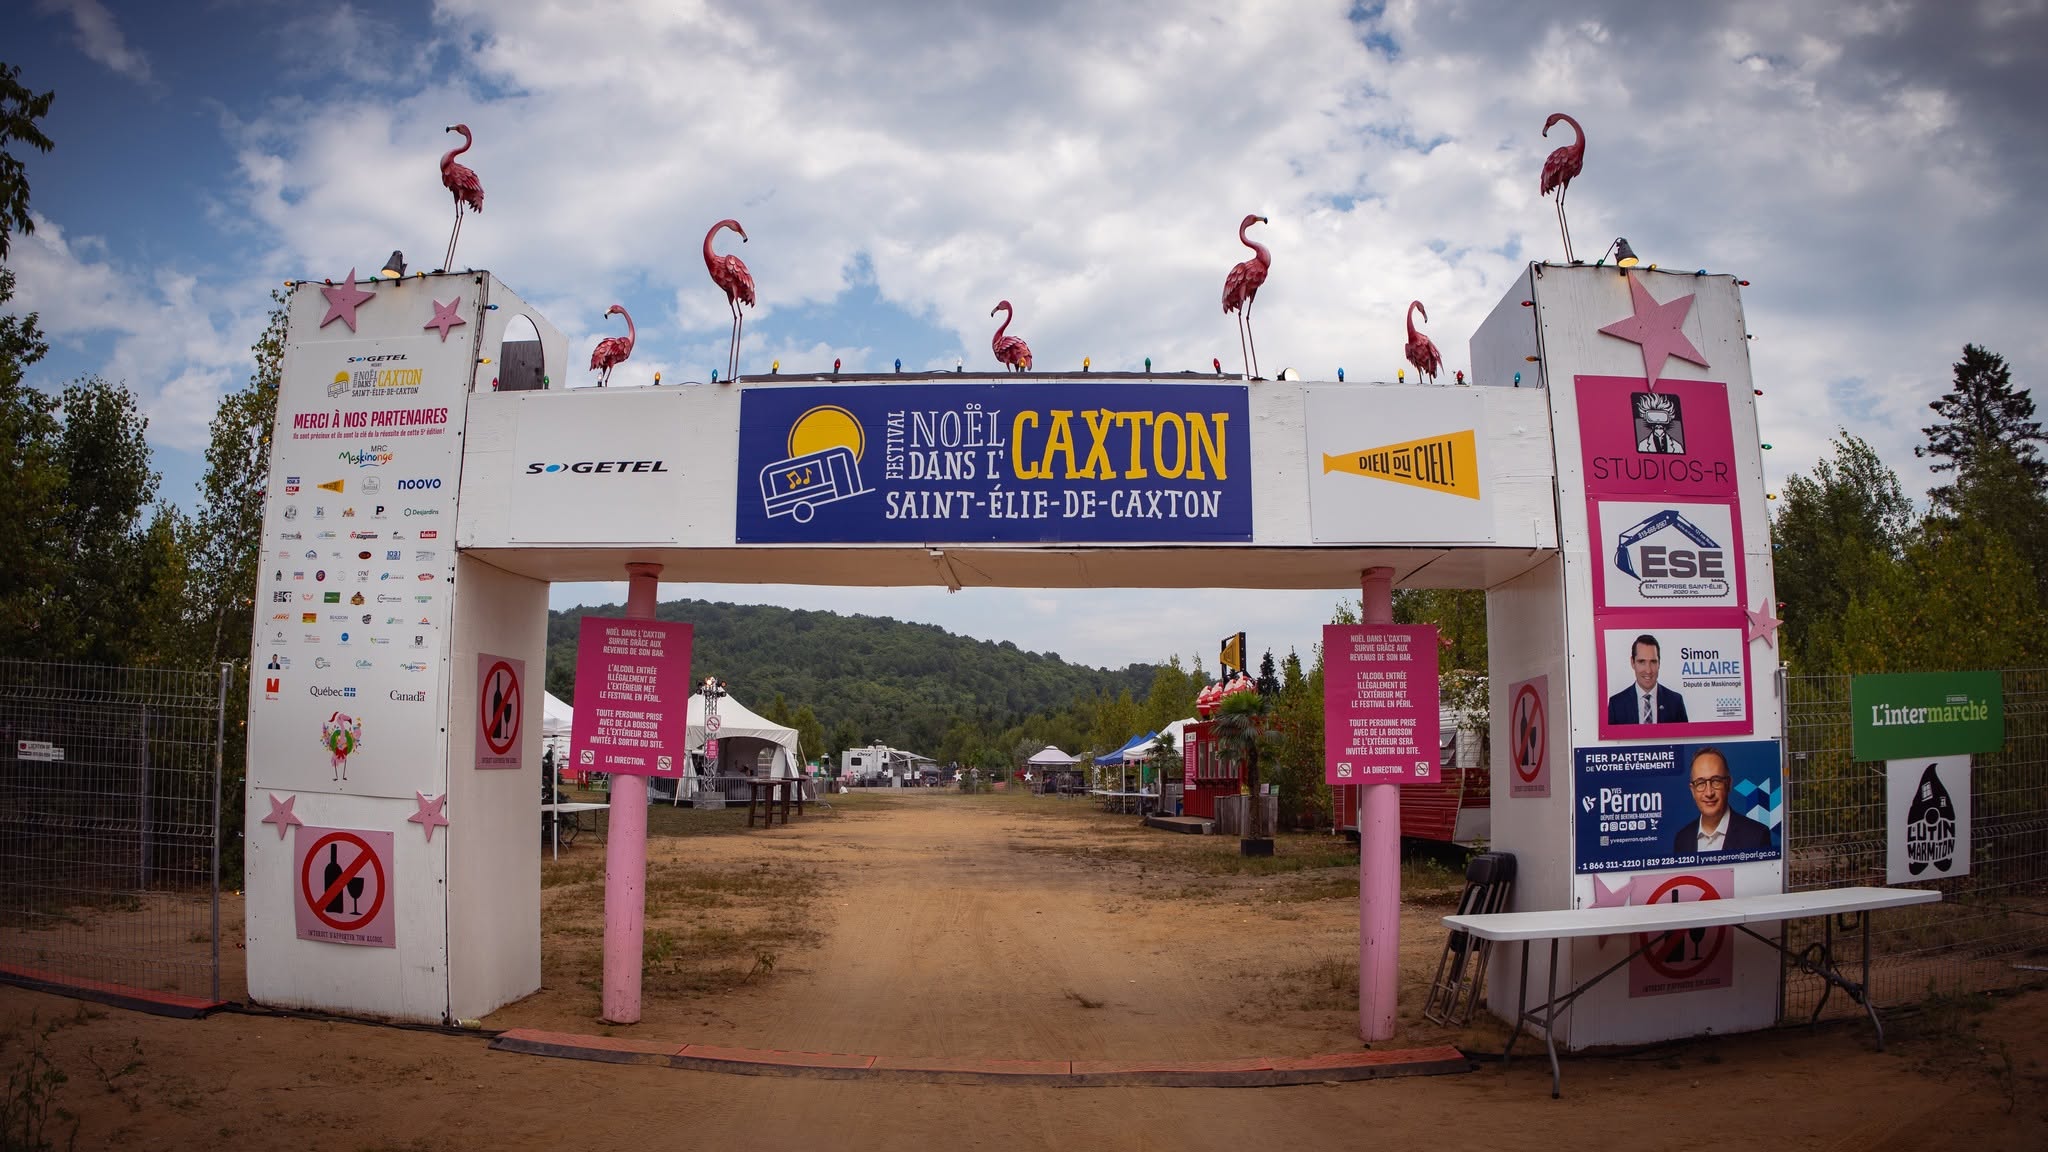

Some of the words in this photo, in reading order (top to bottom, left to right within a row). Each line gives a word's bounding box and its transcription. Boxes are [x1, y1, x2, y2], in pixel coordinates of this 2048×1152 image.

[359, 368, 377, 380] NOËL
[378, 368, 422, 387] CAXTON
[358, 380, 372, 388] DANS
[352, 387, 419, 397] SAINT-ÉLIE-DE-CAXTON
[294, 413, 329, 429] MERCI
[332, 409, 340, 428] À
[344, 411, 367, 427] NOS
[371, 408, 448, 427] PARTENAIRES
[910, 403, 1005, 448] NOËL
[311, 432, 330, 440] précieux
[885, 410, 904, 480] FESTIVAL
[1012, 408, 1229, 480] CAXTON
[526, 460, 668, 474] SOGETEL
[908, 450, 976, 480] DANS
[987, 450, 1003, 479] L'
[1359, 452, 1390, 474] DIEU
[1393, 455, 1411, 472] DU
[1414, 441, 1455, 487] CIEL!
[1593, 456, 1728, 483] STUDIOS-R
[398, 479, 441, 489] noovo
[886, 484, 1222, 519] SAINT-ÉLIE-DE-CAXTON
[1640, 545, 1725, 578] ESE
[606, 627, 619, 635] NOËL
[622, 629, 637, 638] DANS
[638, 630, 666, 639] L'CAXTON
[609, 638, 629, 646] SURVIE
[630, 638, 648, 647] GRÂCE
[650, 640, 661, 648] AUX
[1367, 635, 1382, 643] DANS
[1384, 635, 1411, 643] L'CAXTON
[603, 646, 628, 654] REVENUS
[638, 648, 650, 656] SON
[1354, 644, 1375, 652] SURVIE
[1377, 643, 1395, 652] GRÂCE
[1397, 644, 1408, 652] AUX
[1681, 647, 1719, 660] Simon
[608, 664, 635, 673] L'ALCOOL
[636, 665, 657, 675] ENTRÉE
[1682, 661, 1740, 675] ALLAIRE
[608, 673, 647, 683] ILLÉGALEMENT
[649, 676, 657, 684] DE
[1357, 672, 1384, 680] L'ALCOOL
[1386, 671, 1407, 680] ENTRÉE
[608, 682, 642, 692] L'EXTÉRIEUR
[643, 685, 656, 693] MET
[1357, 680, 1398, 689] ILLÉGALEMENT
[1399, 681, 1407, 689] DE
[310, 685, 343, 697] Québec
[390, 690, 425, 701] Canada
[608, 691, 633, 700] FESTIVAL
[635, 693, 642, 701] EN
[1358, 690, 1394, 698] L'EXTÉRIEUR
[1352, 700, 1358, 708] LE
[1360, 700, 1385, 708] FESTIVAL
[1387, 700, 1395, 708] EN
[596, 709, 614, 717] TOUTE
[615, 711, 645, 720] PERSONNE
[646, 712, 663, 721] PRISE
[1872, 699, 1988, 726] L'intermarché
[599, 718, 614, 726] AVEC
[624, 720, 631, 728] LA
[633, 721, 657, 729] BOISSON
[1349, 719, 1368, 727] TOUTE
[1369, 719, 1399, 727] PERSONNE
[607, 728, 641, 738] L'EXTÉRIEUR
[643, 731, 658, 739] SERA
[1354, 728, 1368, 736] AVEC
[1370, 728, 1378, 736] DE
[1379, 728, 1387, 736] LA
[1388, 728, 1412, 736] BOISSON
[590, 735, 611, 744] INVITÉE
[612, 736, 617, 745] À
[618, 738, 639, 746] SORTIR
[640, 739, 648, 747] DU
[650, 740, 664, 749] SITE.
[1353, 738, 1360, 746] DE
[1362, 737, 1397, 746] L'EXTÉRIEUR
[1399, 737, 1413, 745] SERA
[1346, 746, 1367, 755] INVITÉE
[1369, 746, 1373, 755] À
[1374, 747, 1396, 755] SORTIR
[1397, 747, 1405, 755] DU
[1406, 747, 1420, 755] SITE.
[605, 755, 613, 763] LA
[614, 756, 646, 766] DIRECTION.
[1586, 754, 1608, 763] FIER
[1611, 752, 1674, 762] PARTENAIRE
[1363, 766, 1371, 774] LA
[1372, 766, 1404, 774] DIRECTION.
[1596, 763, 1623, 771] VOTRE
[1600, 788, 1662, 813] Perron
[1601, 813, 1614, 821] DÉPUTÉ
[1908, 820, 1955, 842] LUTIN
[1610, 836, 1657, 844] yvesperron.quebec
[1605, 860, 1640, 868] 311-1210
[1646, 858, 1660, 866] 819
[1661, 856, 1694, 865] 228-1210
[1700, 851, 1776, 864] yves.perron@parl.gc.ca
